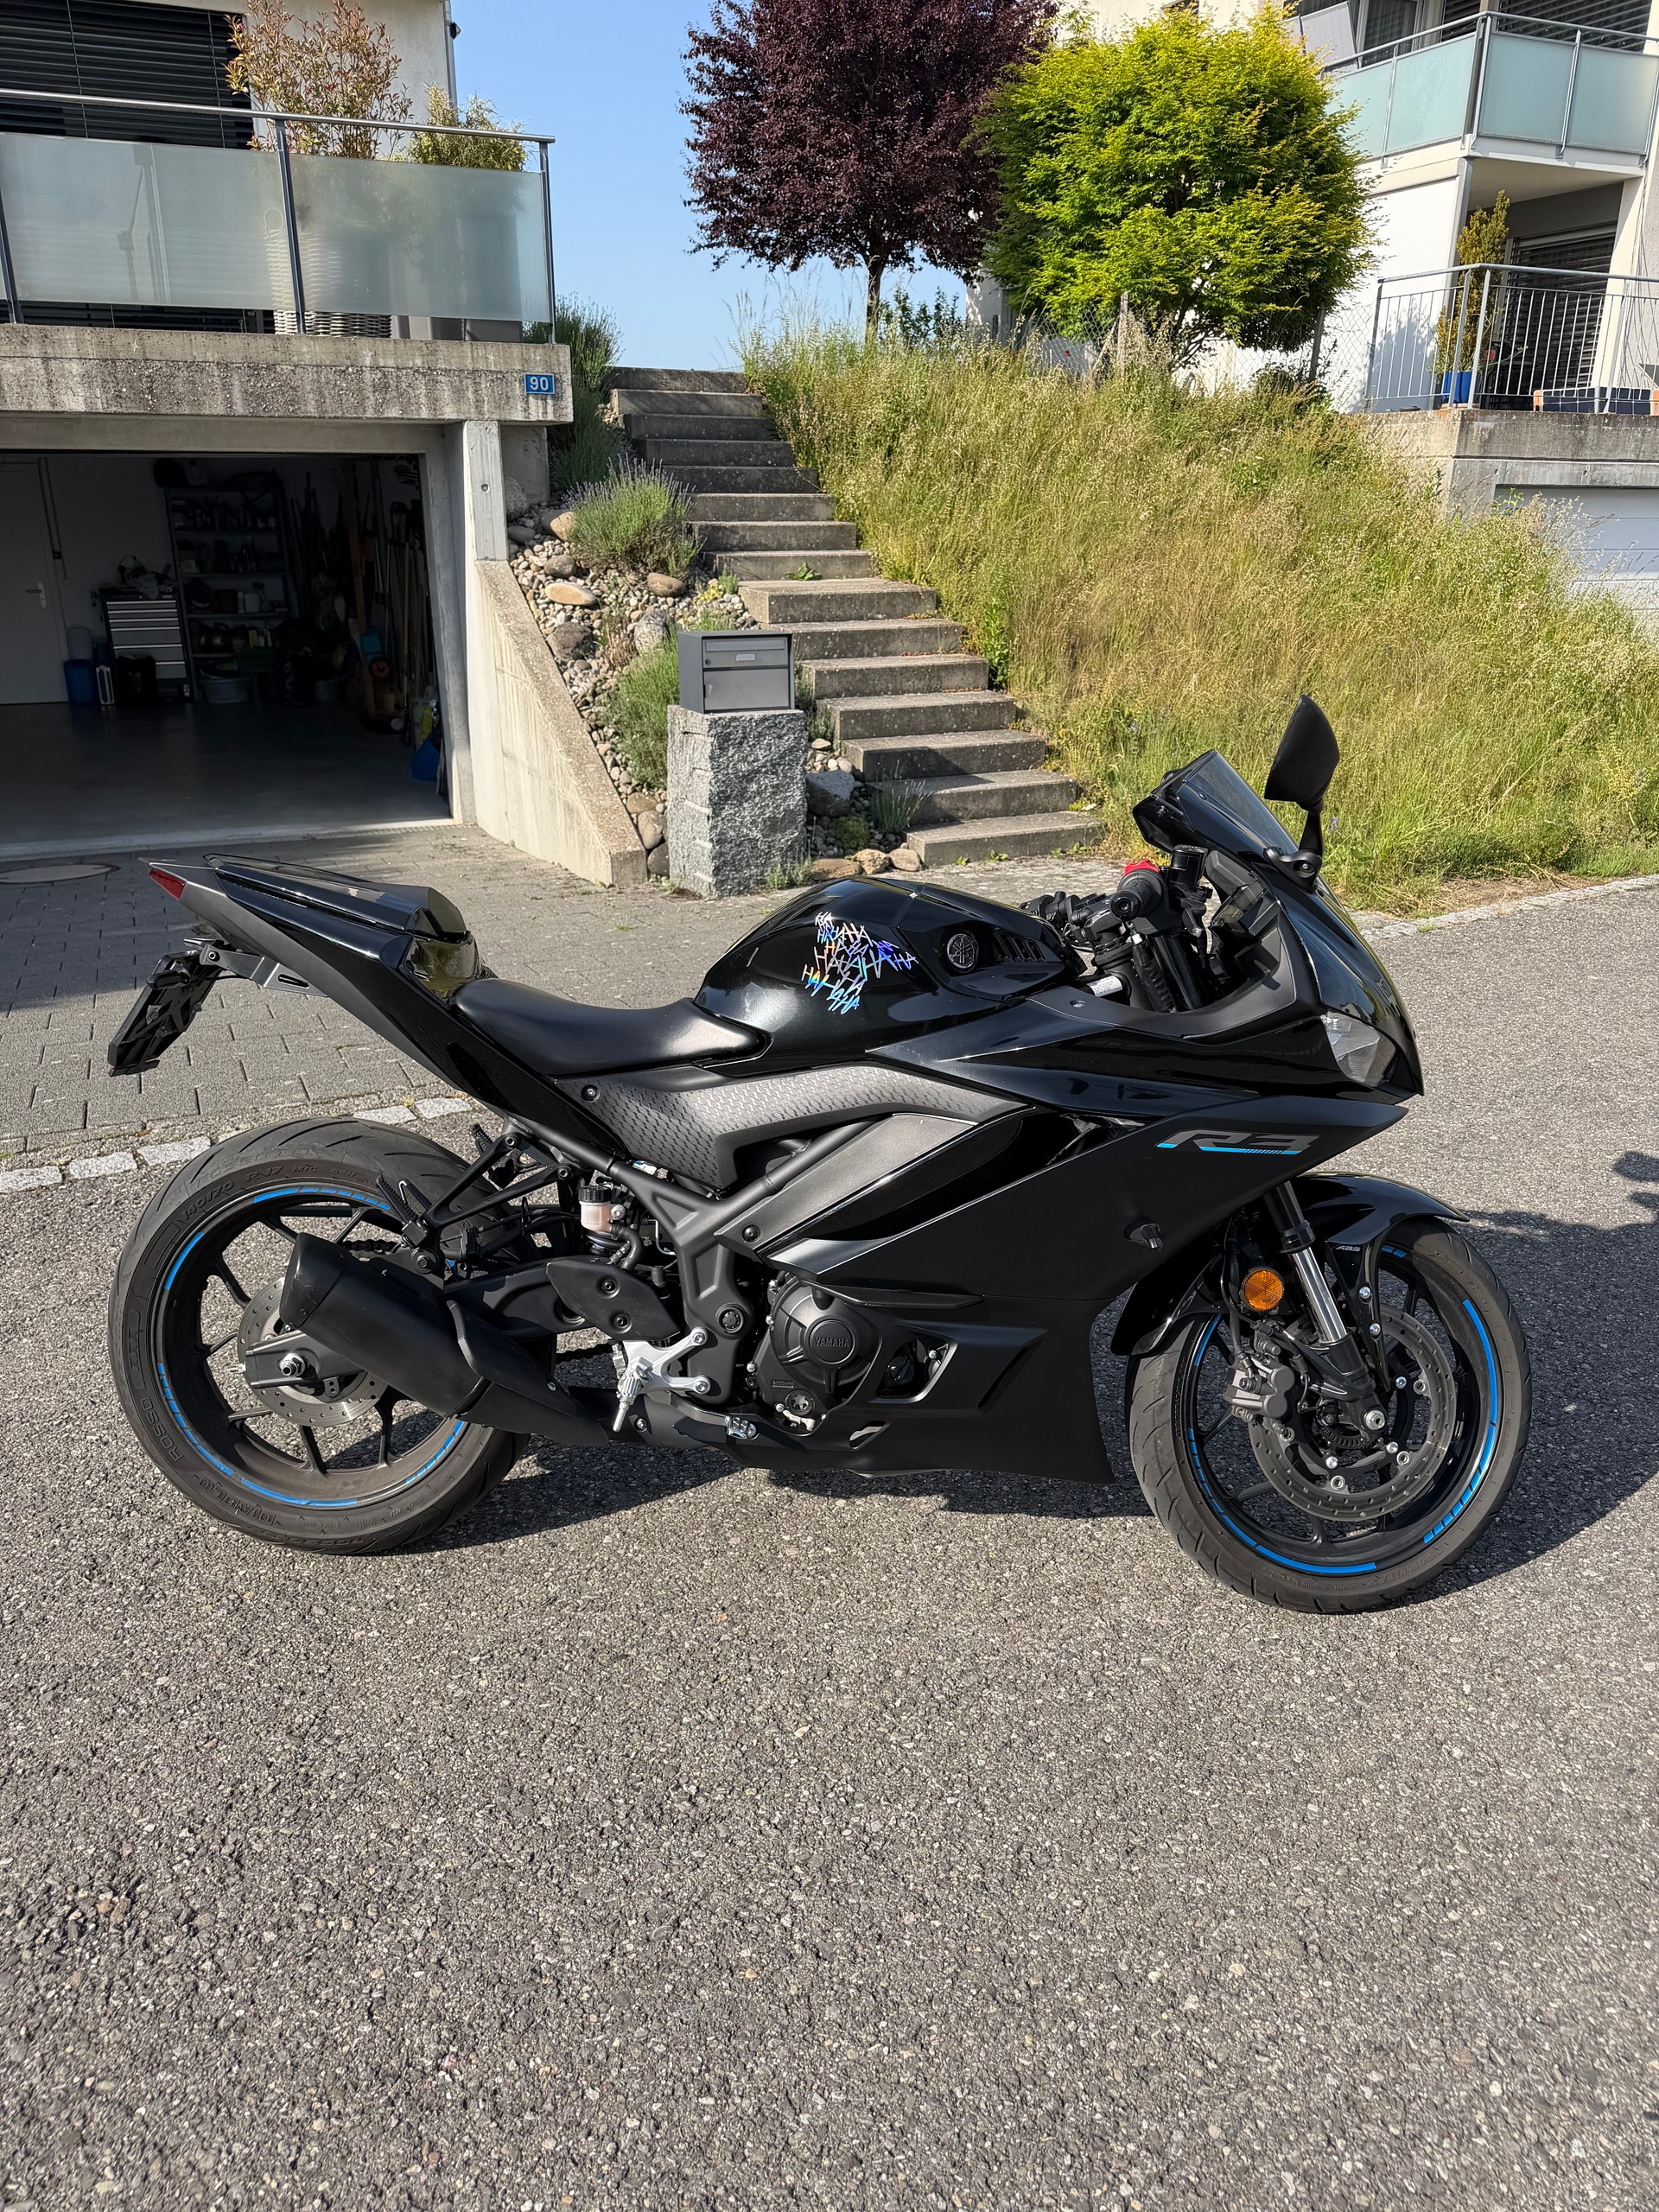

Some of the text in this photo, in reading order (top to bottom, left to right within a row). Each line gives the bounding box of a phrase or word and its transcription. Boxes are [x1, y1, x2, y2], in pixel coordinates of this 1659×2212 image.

[530, 376, 549, 391] 90
[1155, 1129, 1321, 1155] R3
[181, 1179, 236, 1220] 140/70
[815, 1337, 850, 1347] YAMAHA
[140, 1397, 184, 1462] ROSSO
[198, 1478, 276, 1527] DIABLO
